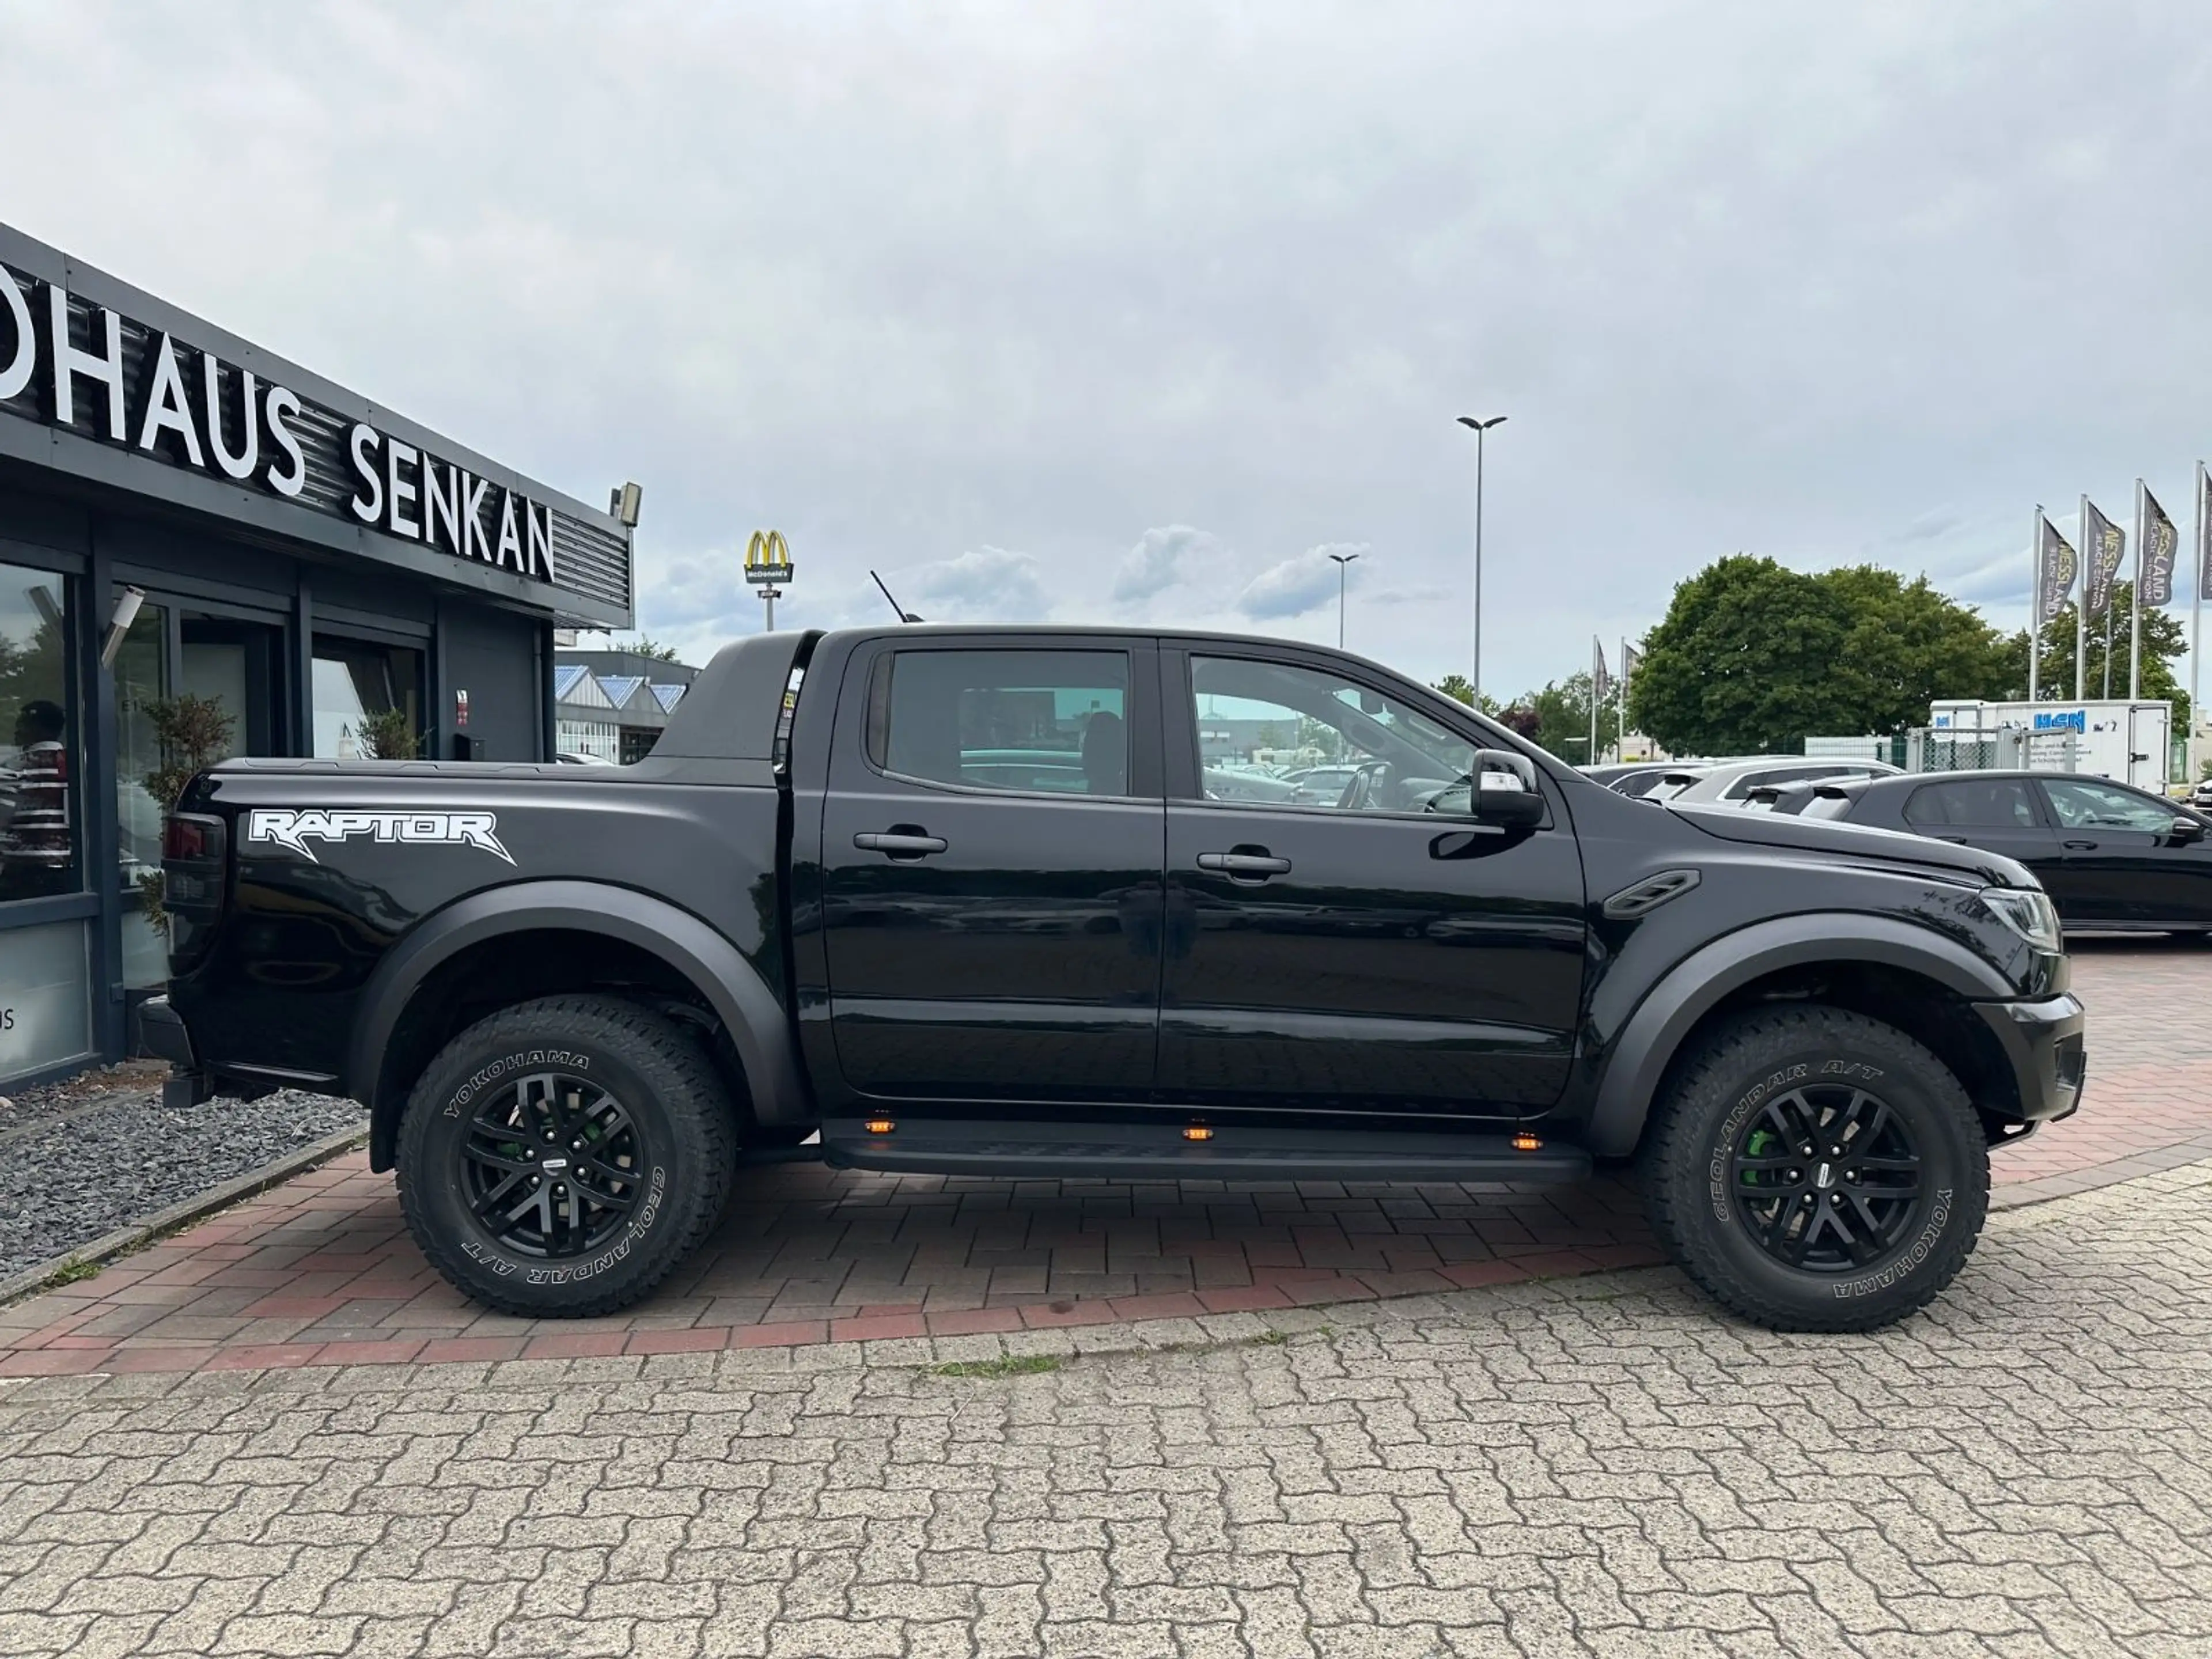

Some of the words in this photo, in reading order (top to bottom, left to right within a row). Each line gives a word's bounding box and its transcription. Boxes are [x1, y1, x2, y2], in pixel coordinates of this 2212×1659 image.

[351, 423, 554, 582] SENKAN
[248, 809, 517, 866] RAPTOR
[444, 1050, 590, 1119] YOKOHAMA
[1711, 1063, 1808, 1222] GEOLANDAR
[1821, 1060, 1884, 1081] A/T
[461, 1241, 517, 1276] A/T
[527, 1166, 665, 1285] GEOLANDAR
[1833, 1188, 1953, 1298] YOKOHAMA
